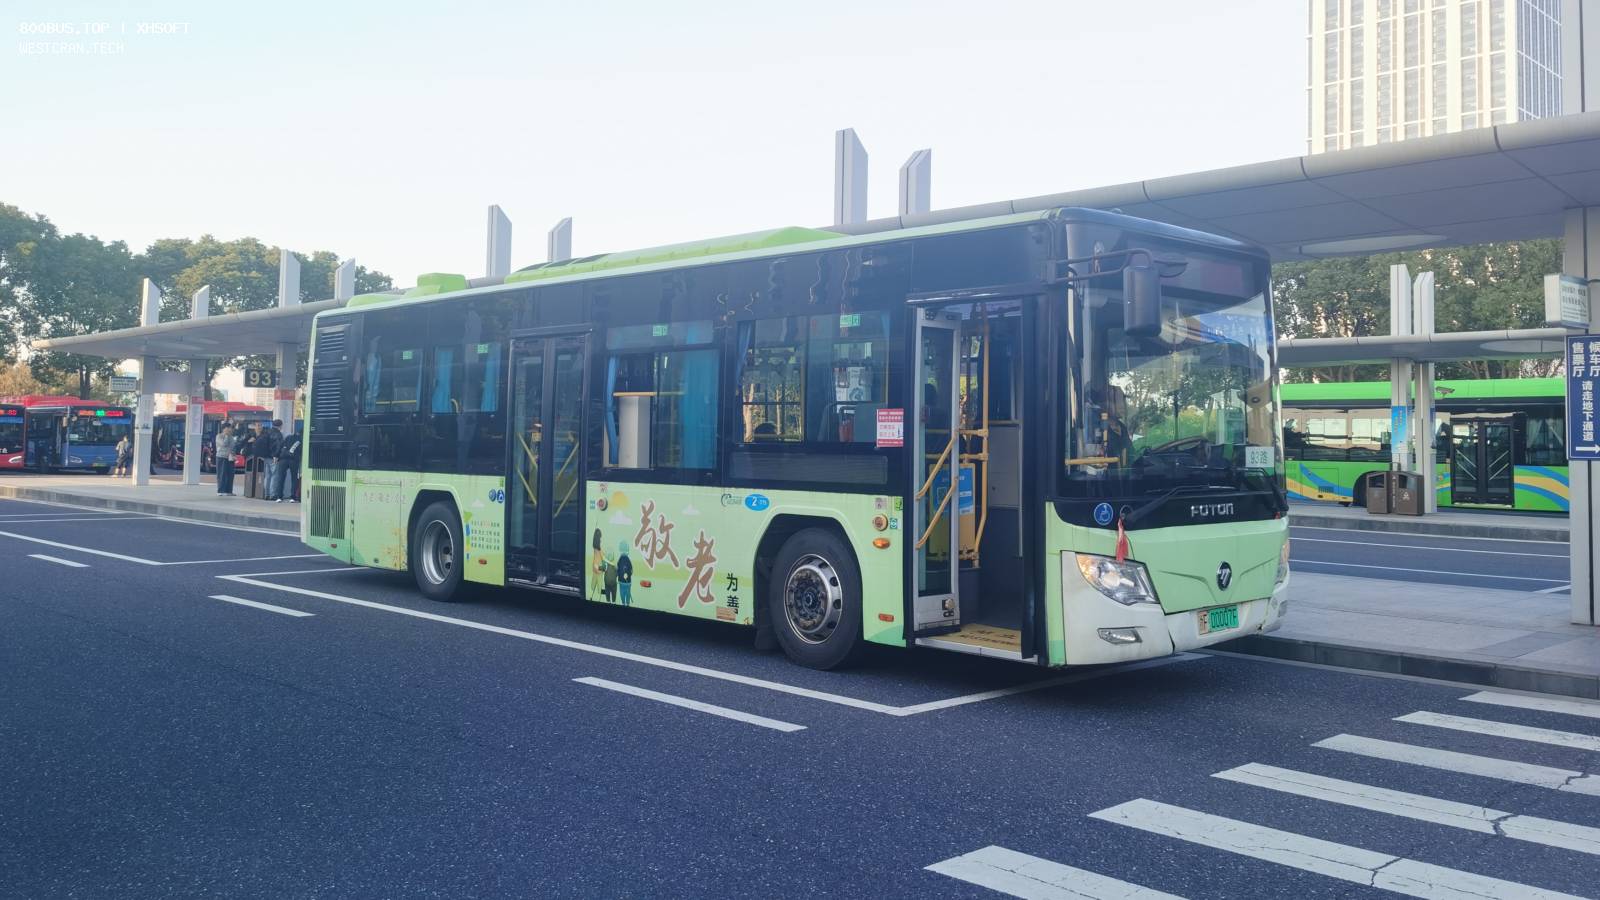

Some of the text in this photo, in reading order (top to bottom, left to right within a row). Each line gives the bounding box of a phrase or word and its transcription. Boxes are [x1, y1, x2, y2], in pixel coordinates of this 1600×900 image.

[1572, 342, 1585, 377] 售票厅
[250, 371, 272, 386] 93
[1582, 380, 1594, 441] 请走地下通道
[1190, 502, 1234, 518] FOTON
[635, 500, 717, 609] 敬老
